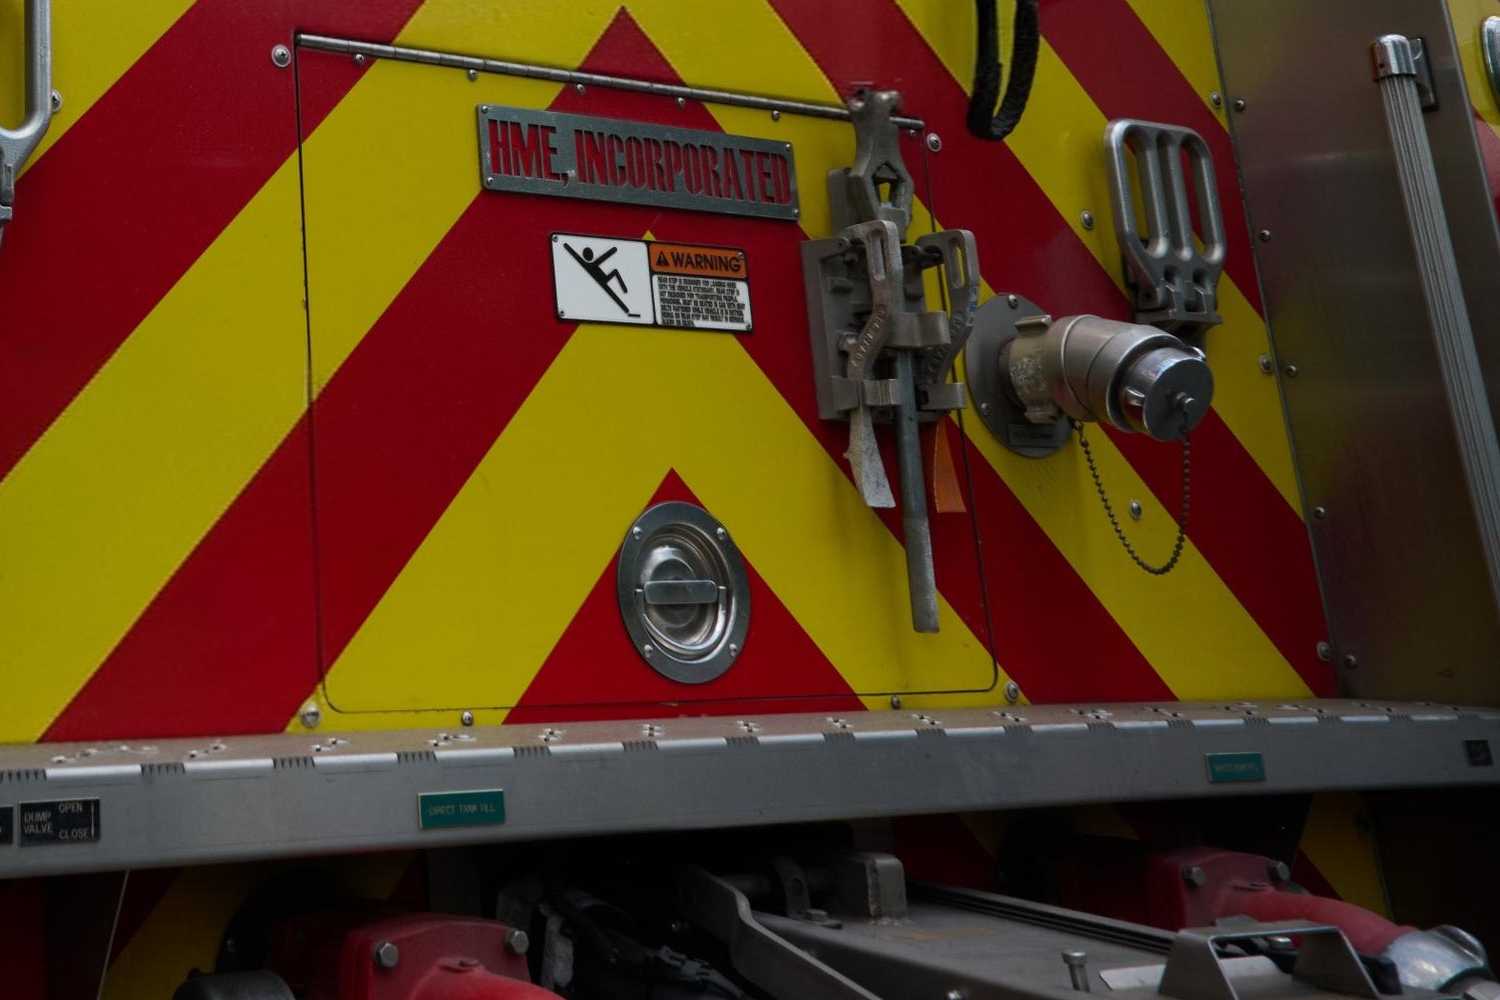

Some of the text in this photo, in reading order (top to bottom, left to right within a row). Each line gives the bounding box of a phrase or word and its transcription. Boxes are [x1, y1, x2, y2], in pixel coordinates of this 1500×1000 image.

[488, 118, 794, 206] HME, INCORPORATED
[670, 251, 741, 273] WARNING
[59, 801, 83, 813] OPEN
[24, 811, 52, 823] DUMP
[23, 822, 53, 834] VALVE
